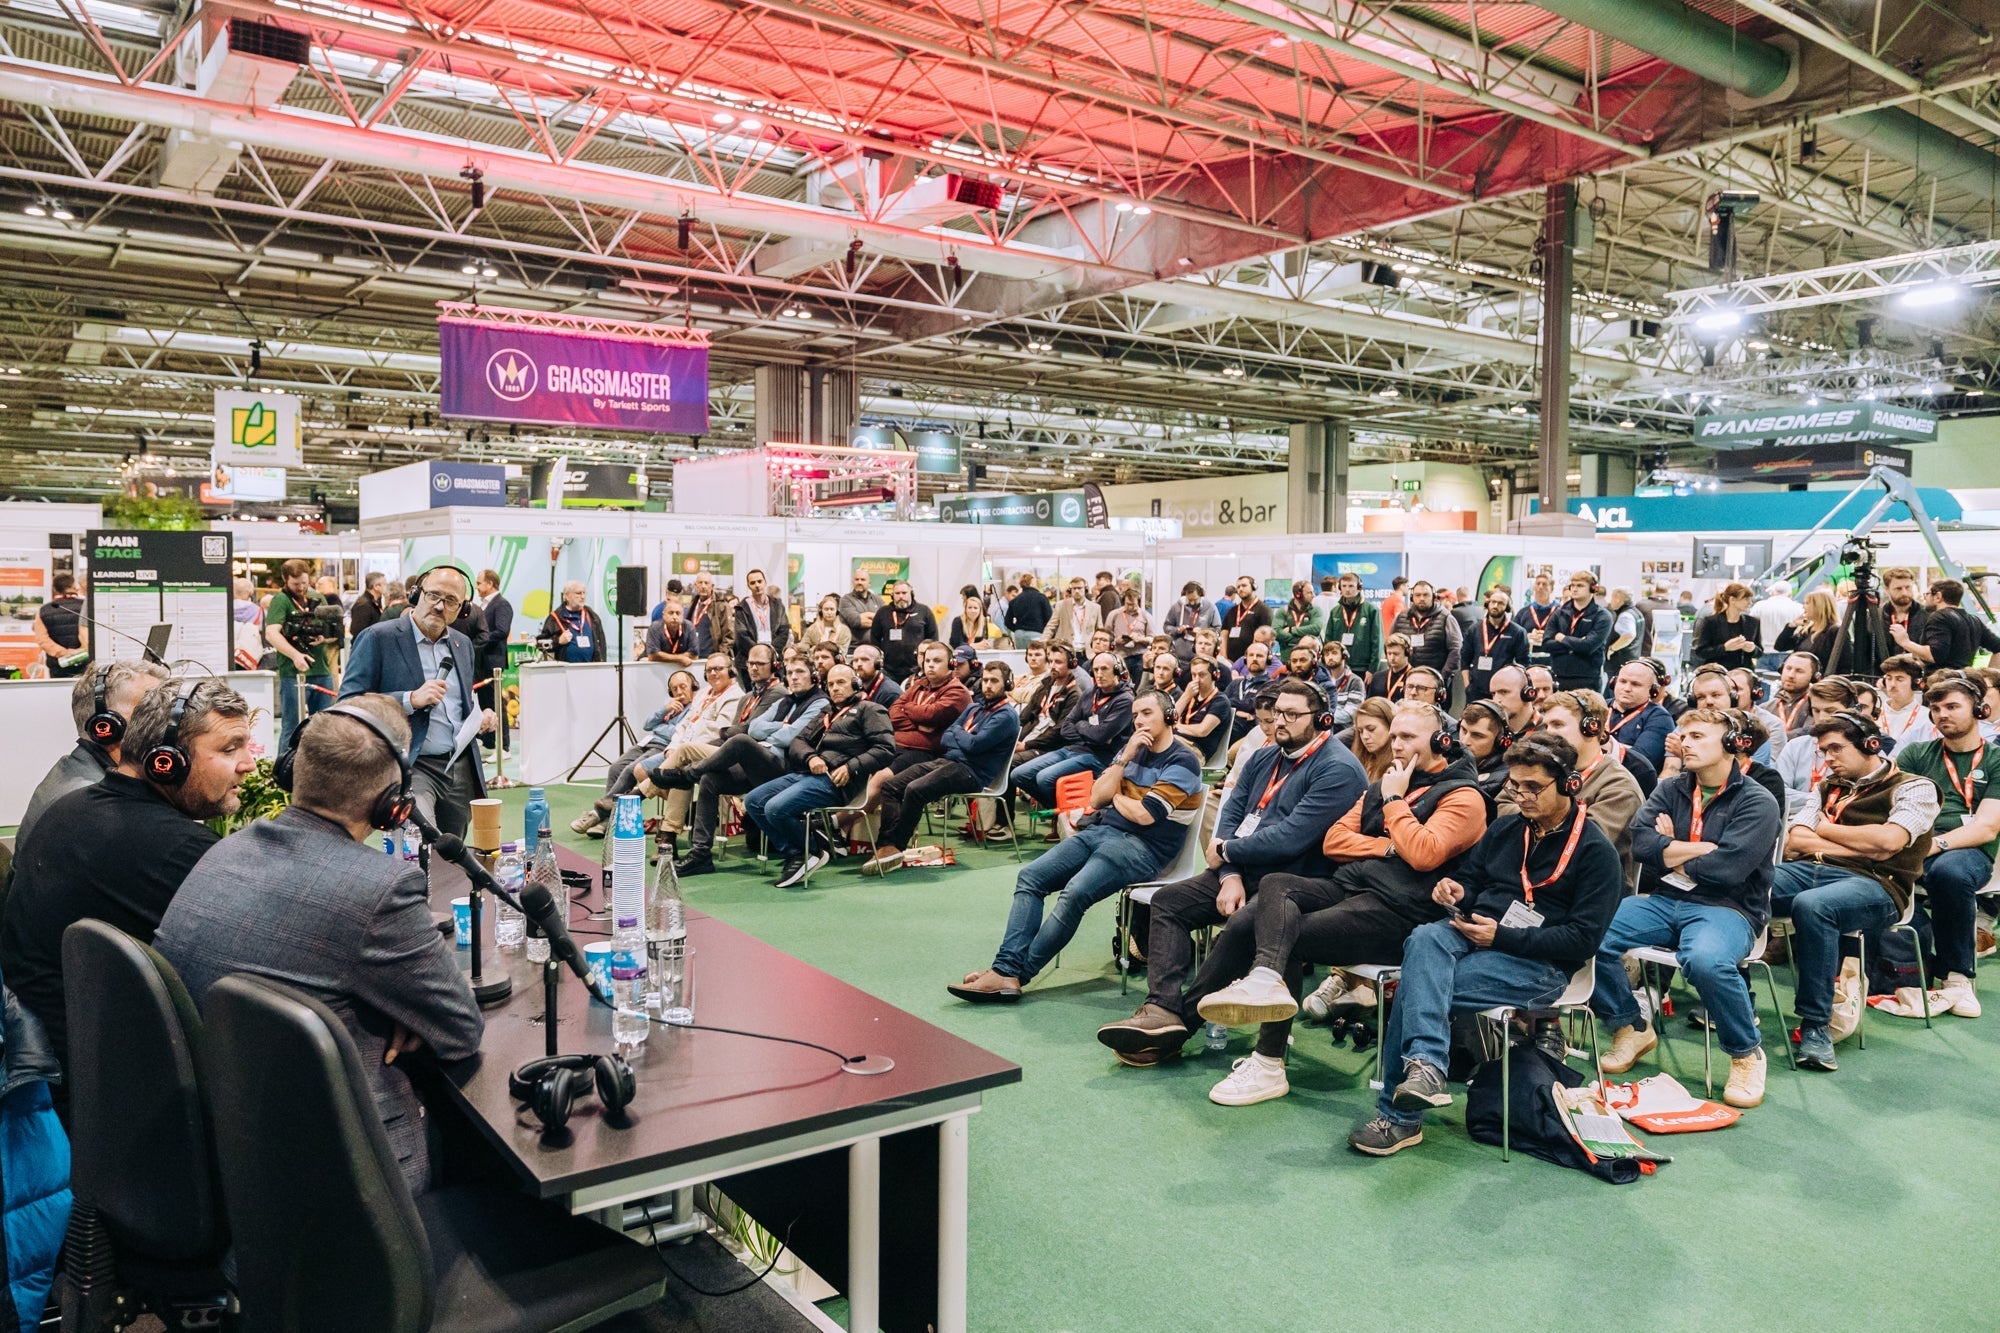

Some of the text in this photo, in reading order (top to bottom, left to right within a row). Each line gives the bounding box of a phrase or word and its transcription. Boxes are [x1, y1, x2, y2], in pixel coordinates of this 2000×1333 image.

[547, 364, 671, 400] GRASSMASTER
[593, 398, 671, 413] By Tarkett Sports
[1702, 410, 1855, 437] RANSOMES
[1872, 410, 1934, 434] RANSOMES
[916, 446, 957, 455] CONTRACTORS
[454, 478, 500, 490] GRASSMASTER
[992, 505, 1034, 516] CONTRACTORS
[1164, 500, 1215, 526] food
[1218, 499, 1235, 524] &
[1240, 497, 1277, 524] bar
[1597, 507, 1633, 528] ICL
[97, 536, 139, 547] MAIN
[94, 548, 142, 559] STAGE
[93, 571, 135, 579] LEARNING
